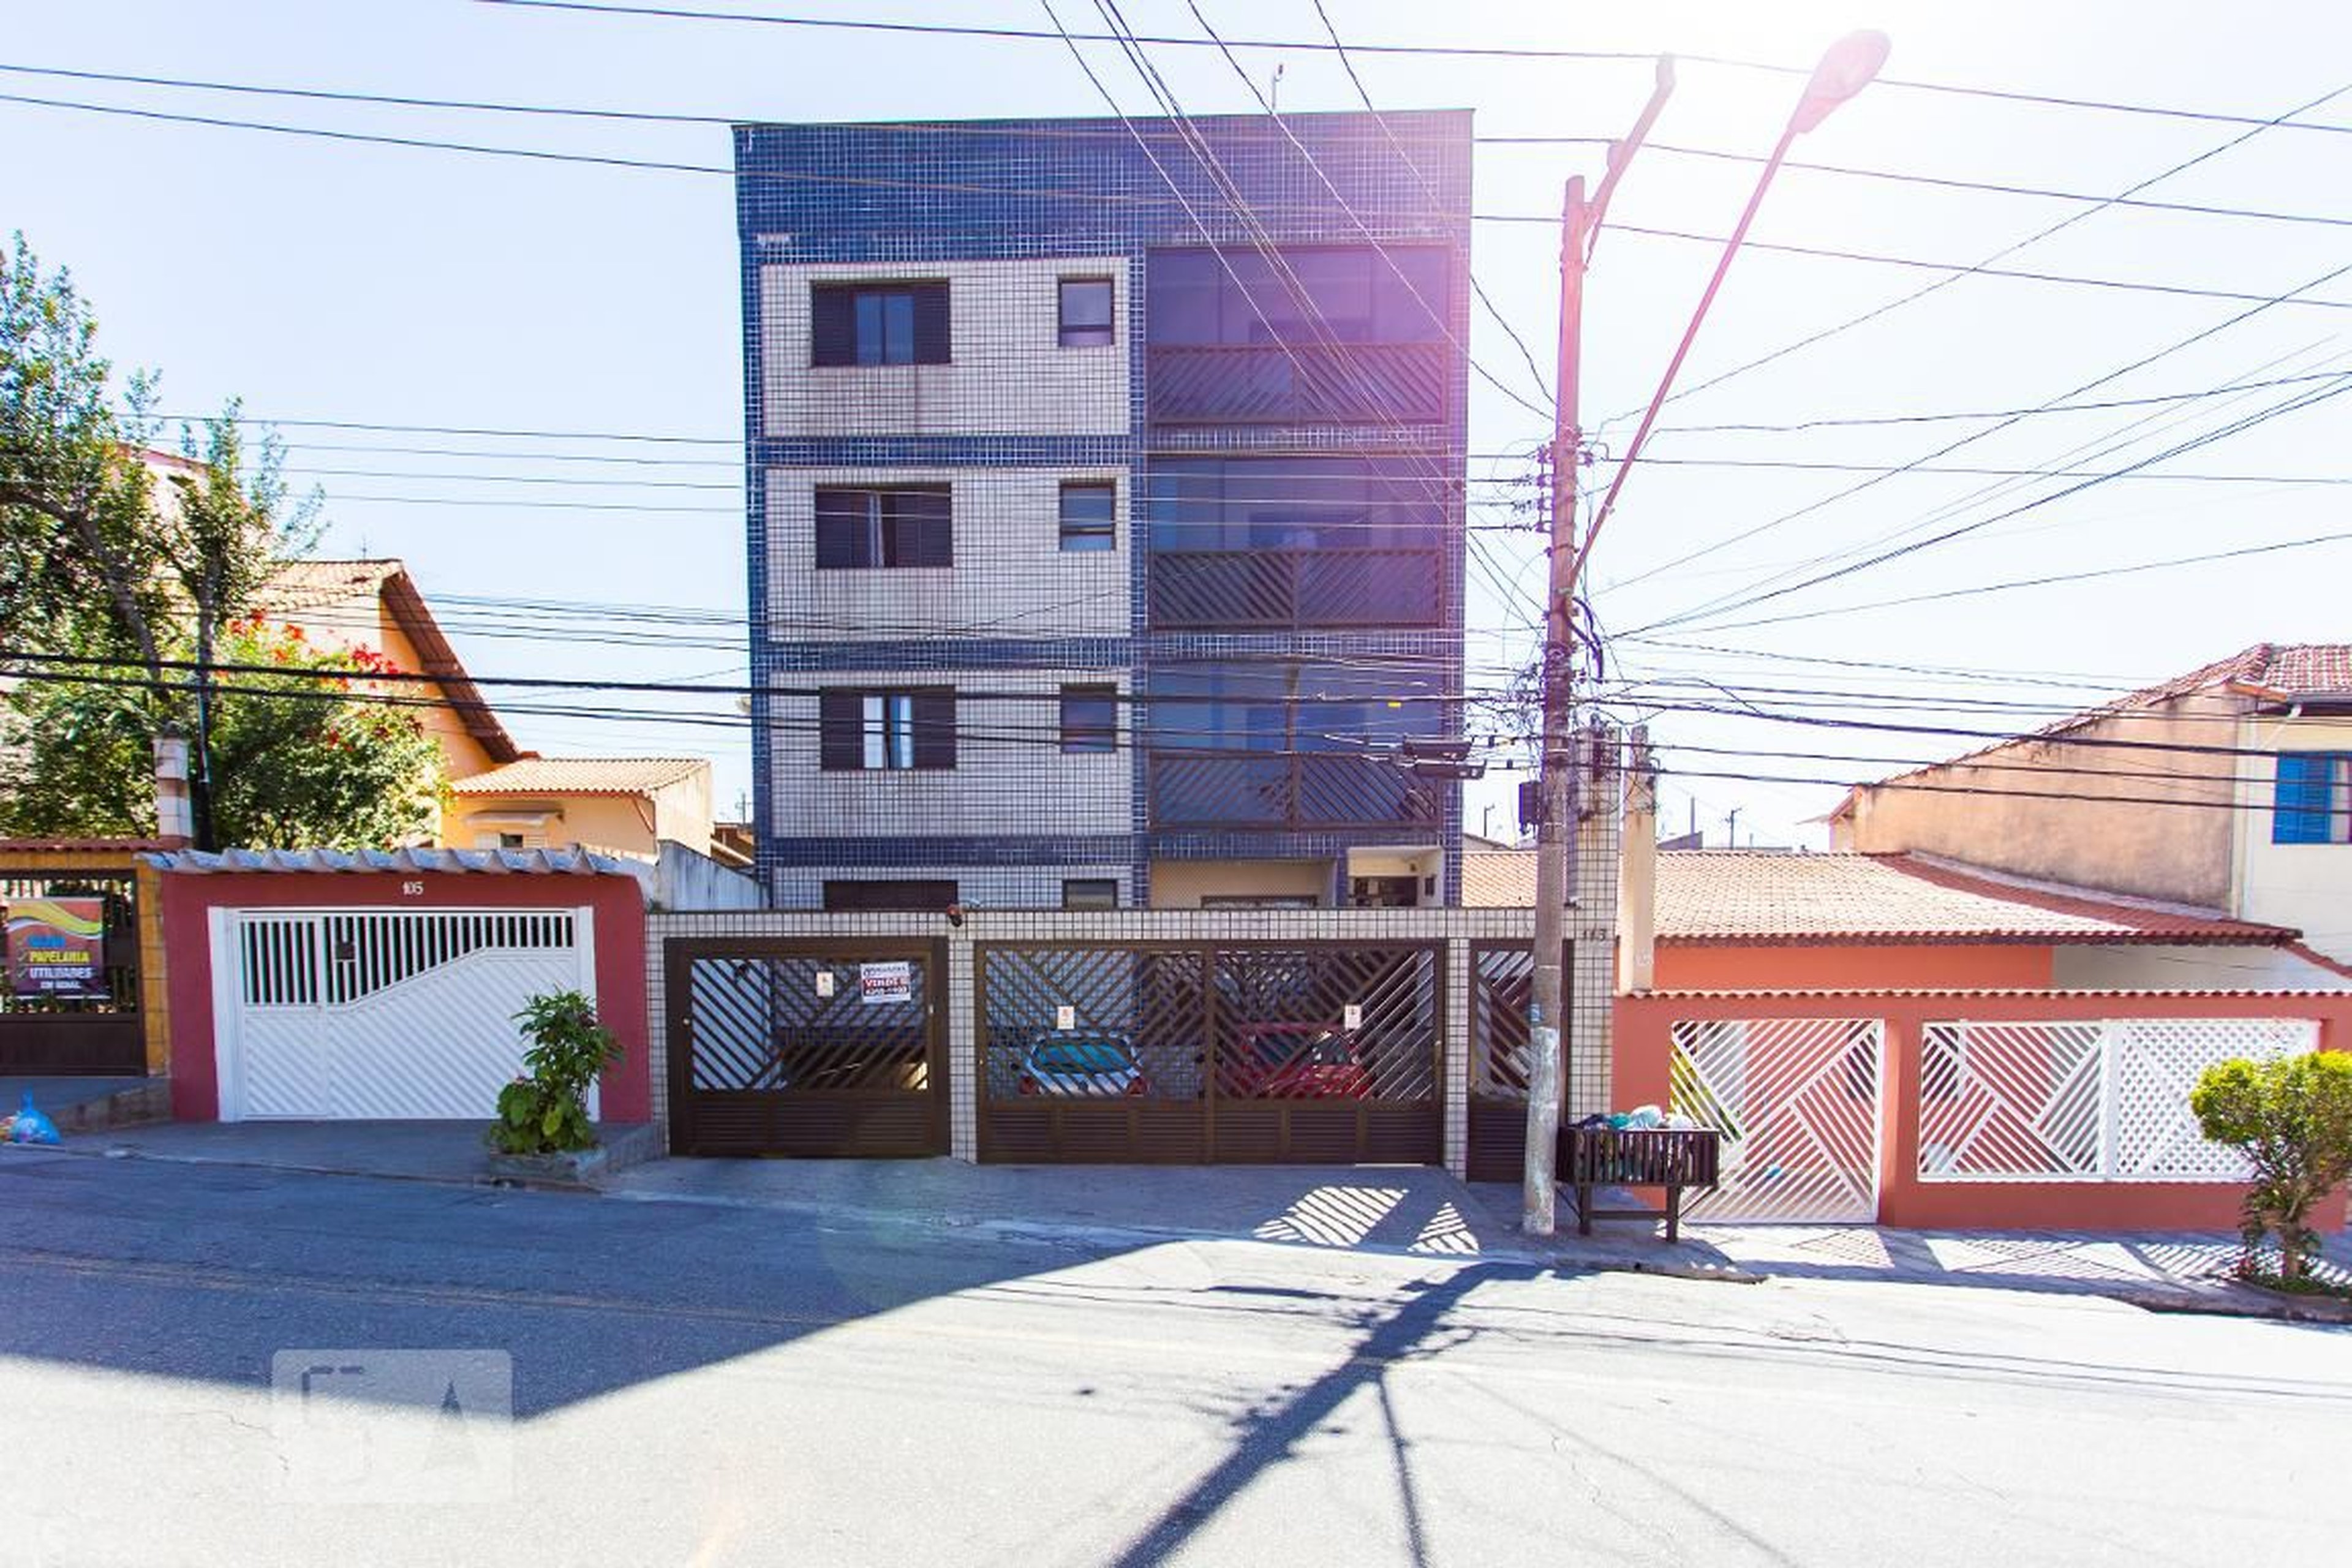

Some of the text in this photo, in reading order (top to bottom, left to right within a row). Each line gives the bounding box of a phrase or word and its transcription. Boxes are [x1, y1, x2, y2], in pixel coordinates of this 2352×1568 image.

[402, 881, 424, 895] 105
[30, 950, 90, 963] PAPELARIA
[30, 967, 92, 979] UTILIDADES
